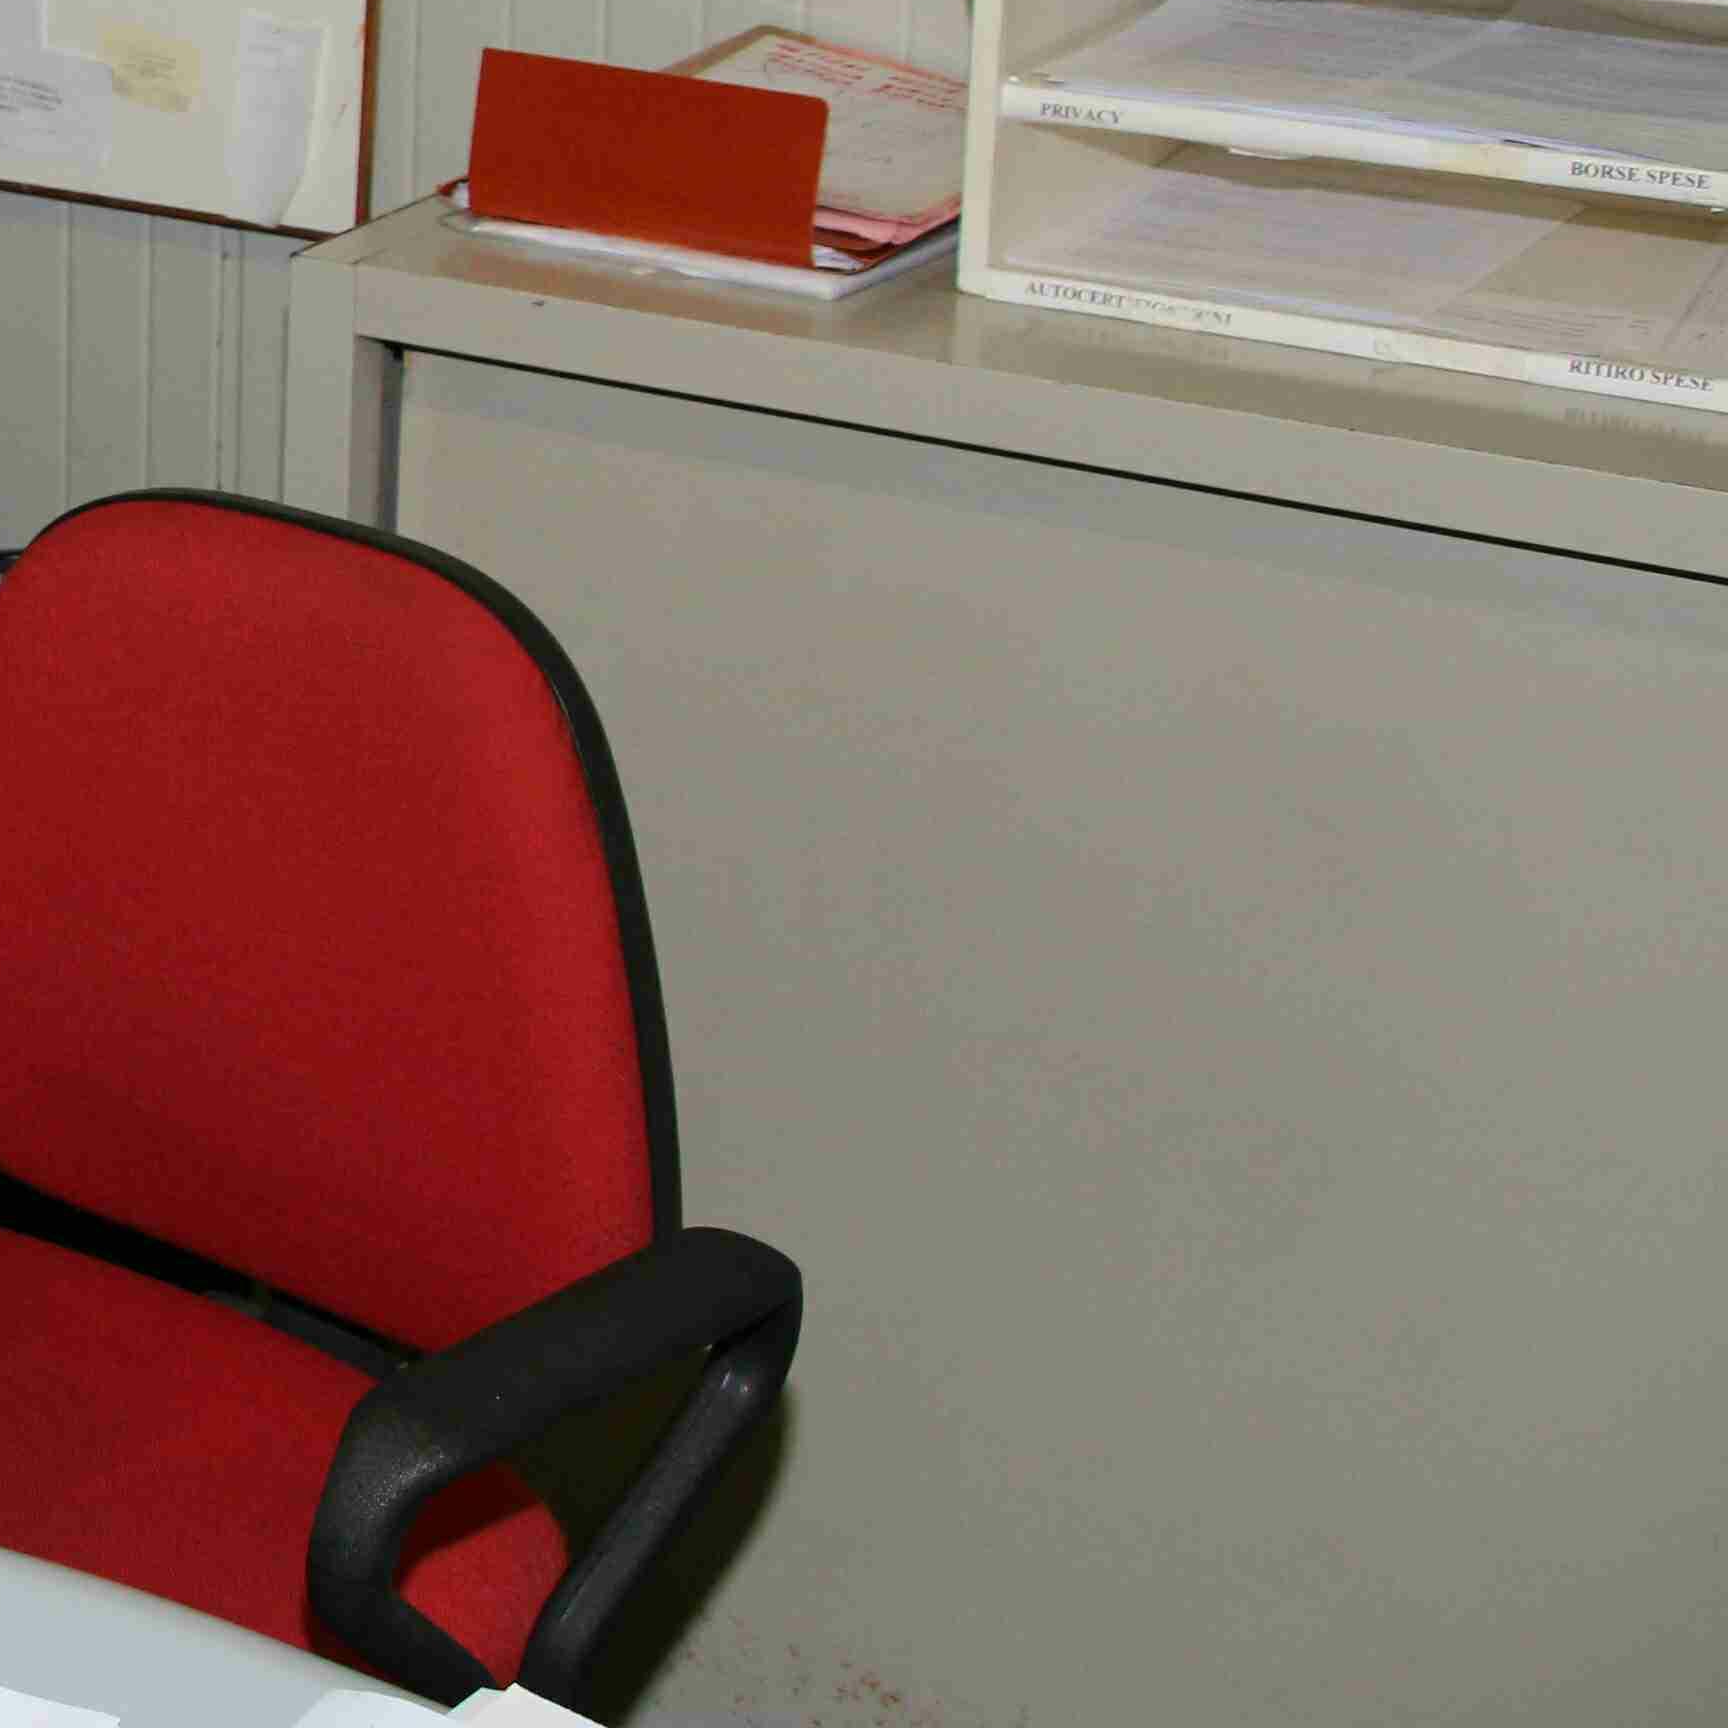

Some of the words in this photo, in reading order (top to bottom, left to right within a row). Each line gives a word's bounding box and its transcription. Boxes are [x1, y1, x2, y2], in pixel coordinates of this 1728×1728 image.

[1039, 100, 1122, 127] PRIVACY
[1569, 159, 1641, 184] BORSE
[1645, 167, 1712, 191] SPESE
[1567, 356, 1645, 383] RITIRO
[1649, 367, 1713, 392] SPESE
